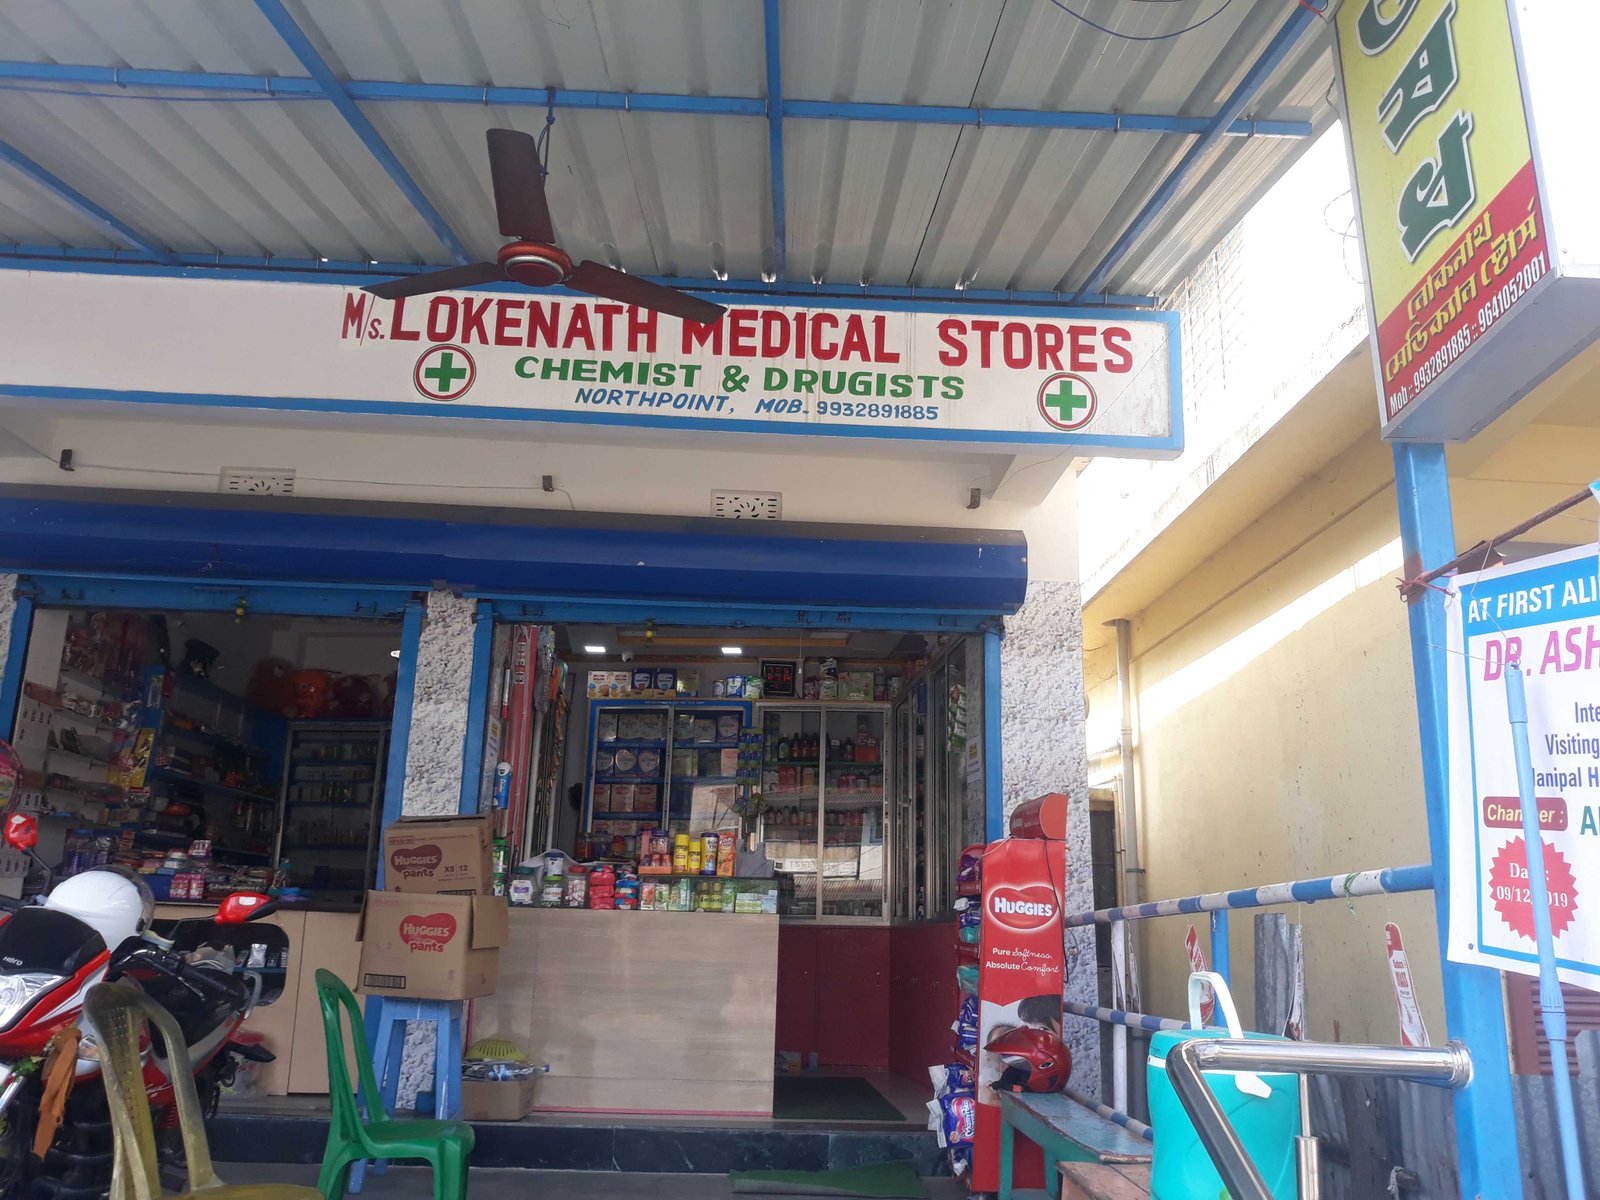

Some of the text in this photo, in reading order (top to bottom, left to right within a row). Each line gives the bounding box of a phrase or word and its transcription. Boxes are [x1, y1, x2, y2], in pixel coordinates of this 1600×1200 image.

[1407, 211, 1492, 321] লোকনাথ
[389, 296, 658, 354] LOKENATH
[682, 308, 901, 364] MEDICAL
[936, 318, 1133, 374] STORES
[1413, 322, 1471, 394] 9932891885
[1478, 250, 1547, 333] 9641052001
[514, 356, 965, 400] CHEMIST & DRUGISTS
[575, 387, 736, 416] NORTHPOINT,
[816, 400, 939, 421] 9932891885
[1467, 596, 1492, 624] AT
[1496, 583, 1555, 618] FIRST
[1544, 732, 1600, 760] Visiting
[1532, 766, 1582, 793] anipal
[403, 868, 435, 880] pants
[993, 896, 1053, 917] HUGGIES
[410, 940, 445, 953] pants
[992, 947, 1011, 956] Pure
[985, 960, 1060, 977] Absolute Comfort
